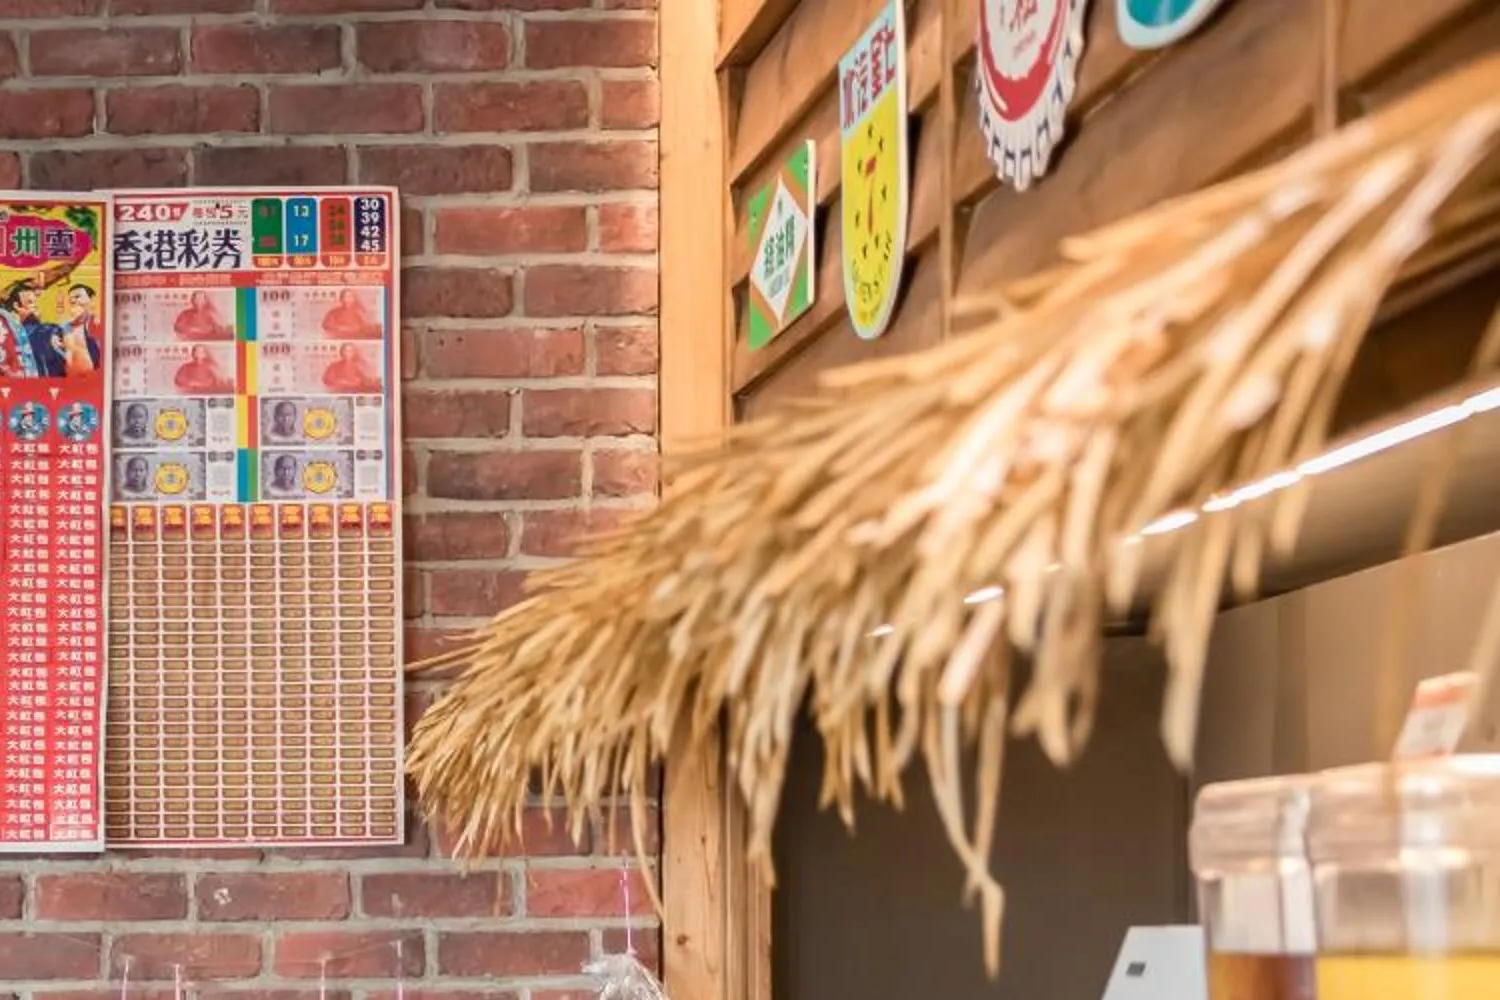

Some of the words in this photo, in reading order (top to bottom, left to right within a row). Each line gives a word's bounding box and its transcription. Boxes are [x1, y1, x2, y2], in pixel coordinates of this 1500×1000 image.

[360, 198, 380, 211] 30
[360, 212, 380, 224] 39
[360, 225, 380, 237] 42
[292, 233, 310, 247] 17
[360, 239, 380, 251] 45
